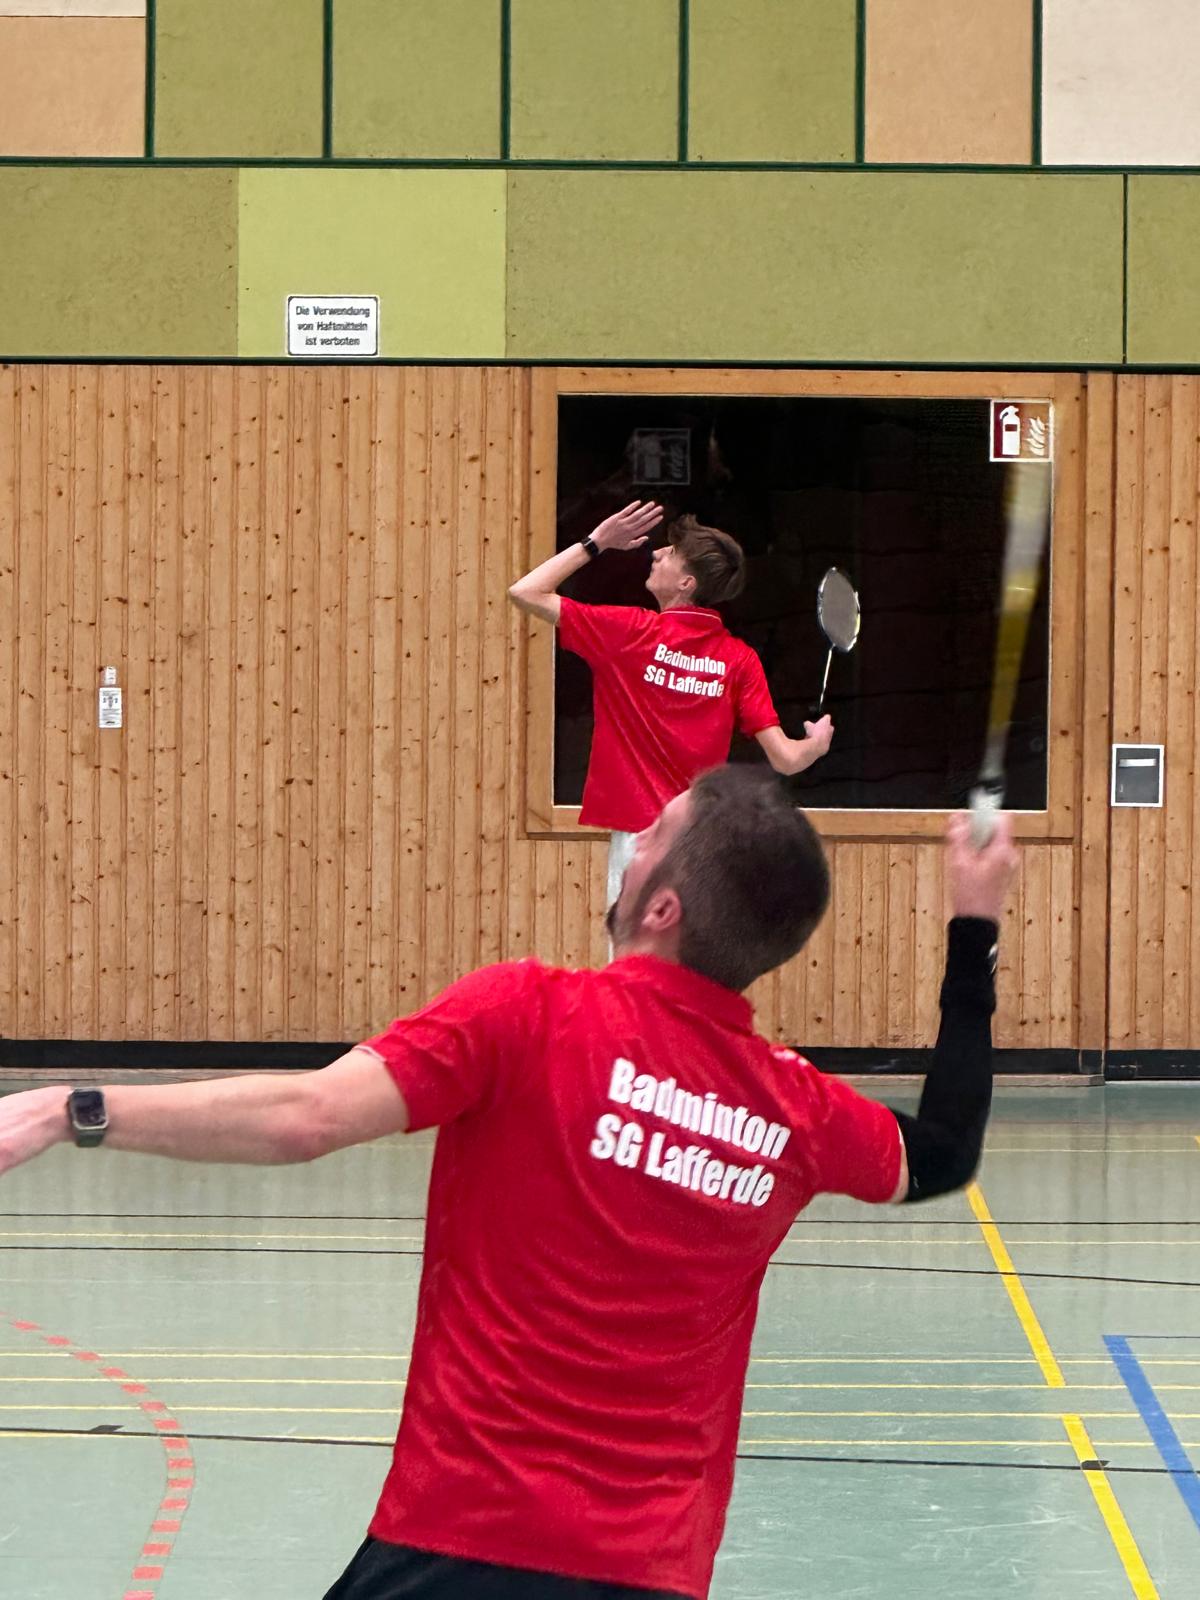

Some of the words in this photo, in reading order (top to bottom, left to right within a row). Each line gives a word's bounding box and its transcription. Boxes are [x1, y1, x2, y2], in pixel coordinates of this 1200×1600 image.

[296, 306, 309, 315] Die
[313, 306, 370, 318] Verwendung
[305, 336, 317, 345] ist
[320, 336, 361, 345] verboten
[654, 643, 726, 676] Badminton
[644, 664, 666, 686] SG
[668, 672, 725, 697] Lafferde
[608, 1057, 791, 1160] Badminton
[590, 1113, 644, 1168] SG
[644, 1132, 775, 1207] Lafferde
